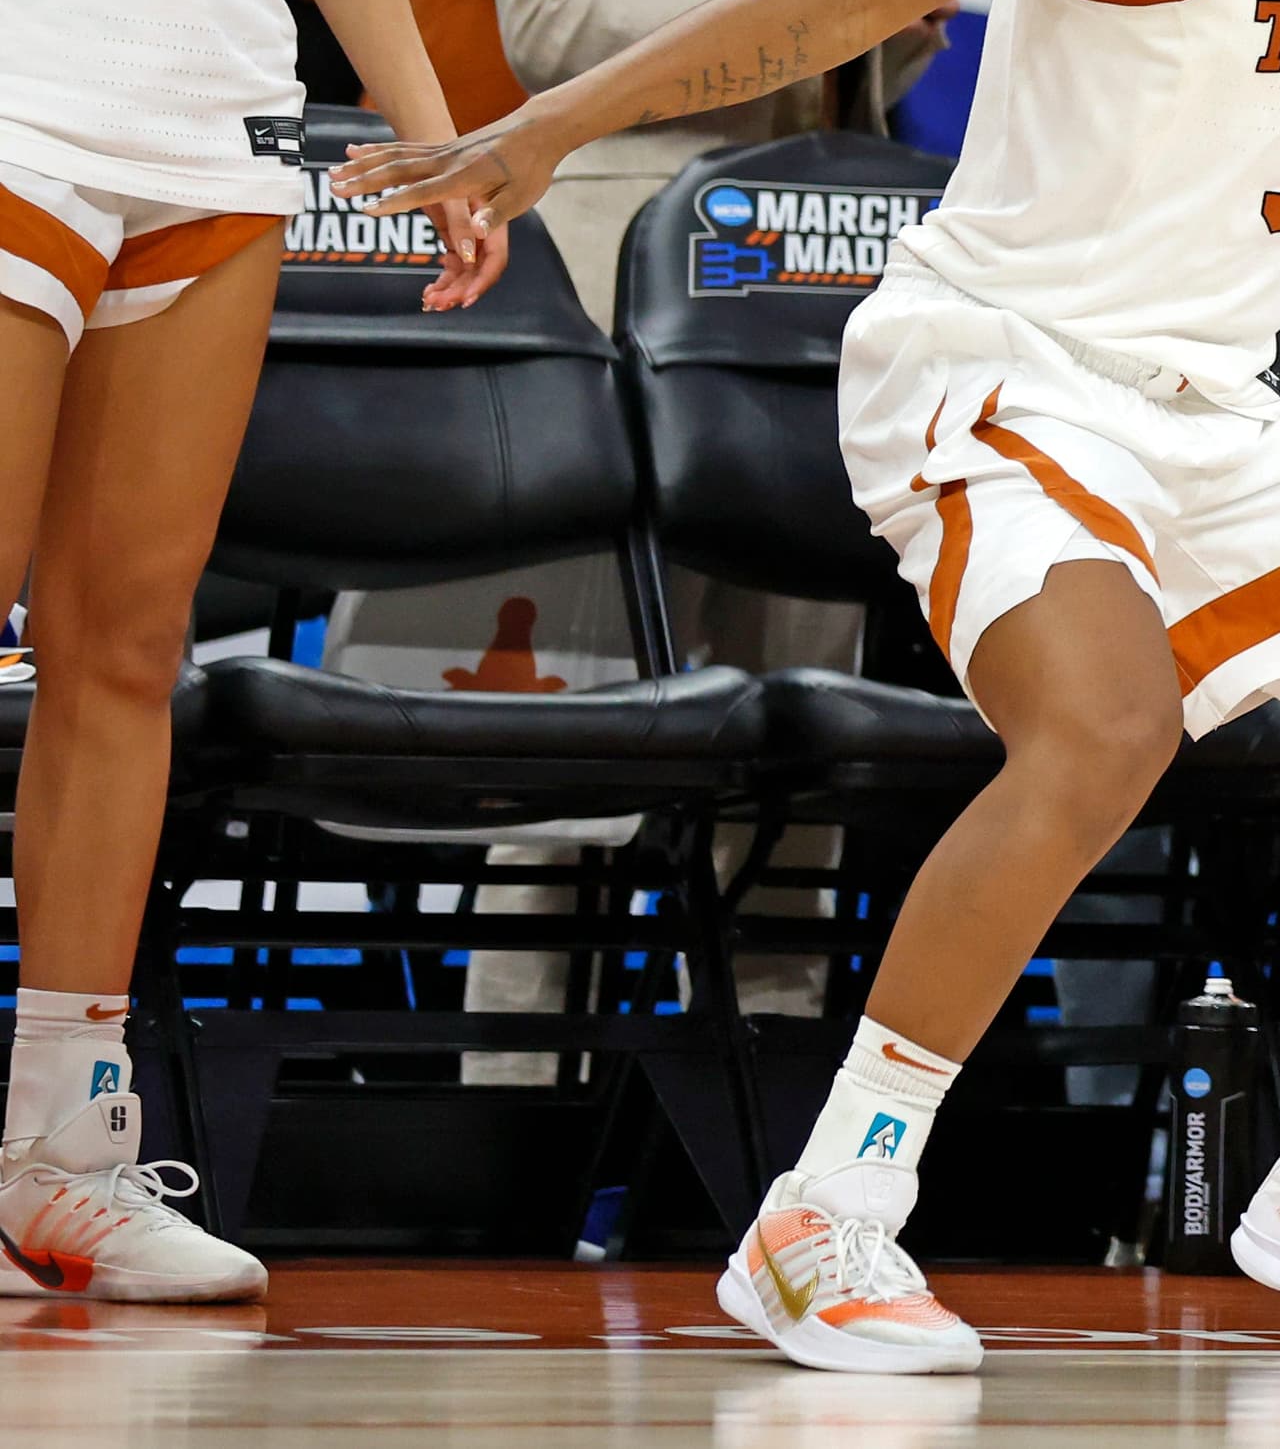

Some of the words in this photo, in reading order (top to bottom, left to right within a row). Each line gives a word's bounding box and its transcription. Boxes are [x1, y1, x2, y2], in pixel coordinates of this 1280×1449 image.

[284, 212, 449, 256] MADNE
[757, 191, 919, 236] MARCH
[784, 234, 898, 276] MAD
[1184, 1112, 1206, 1236] BODYARMOR
